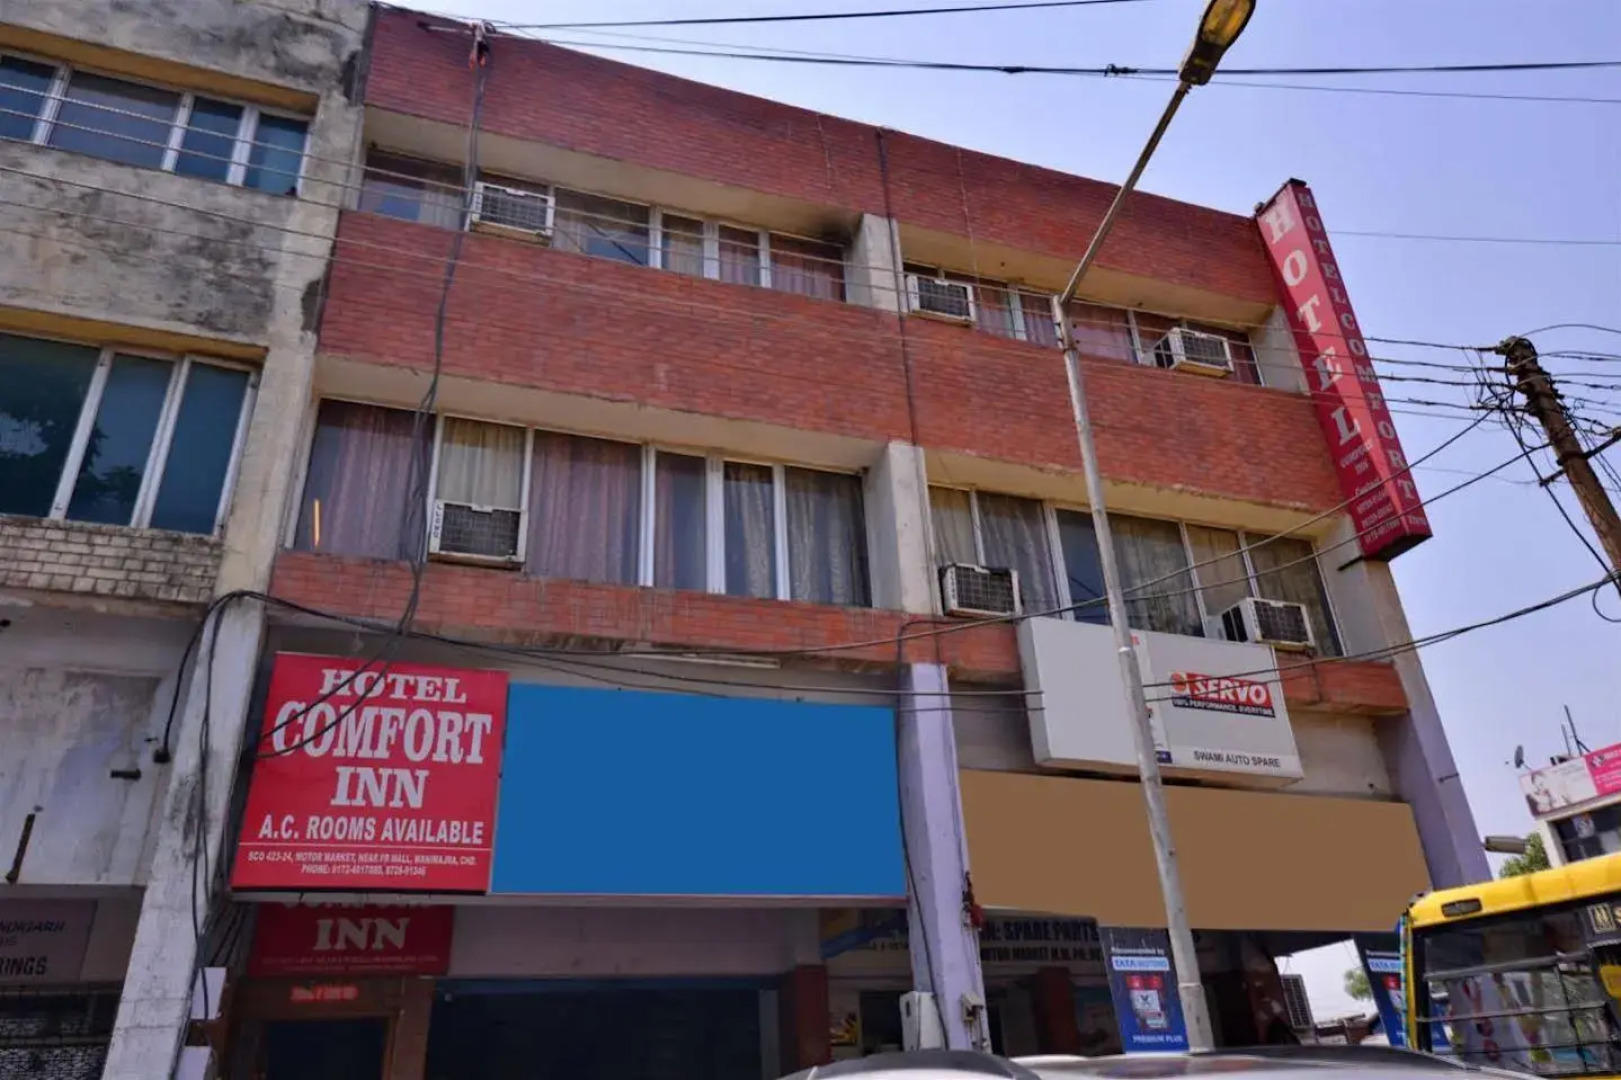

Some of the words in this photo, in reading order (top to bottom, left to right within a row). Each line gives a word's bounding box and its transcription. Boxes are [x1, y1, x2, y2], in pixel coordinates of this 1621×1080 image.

[1264, 193, 1361, 446] HOTEL
[319, 669, 467, 702] HOTEL
[1193, 676, 1267, 704] SERVO
[272, 701, 492, 764] COMFORT
[1193, 750, 1224, 762] SWAMI
[1226, 753, 1250, 765] AUTO
[1251, 756, 1281, 768] SPARE
[330, 766, 429, 808] INN
[258, 815, 299, 840] A.C.
[306, 816, 376, 841] ROOMS
[381, 818, 484, 844] AVAILABLE
[313, 918, 410, 950] INN
[1003, 919, 1051, 940] SPARE
